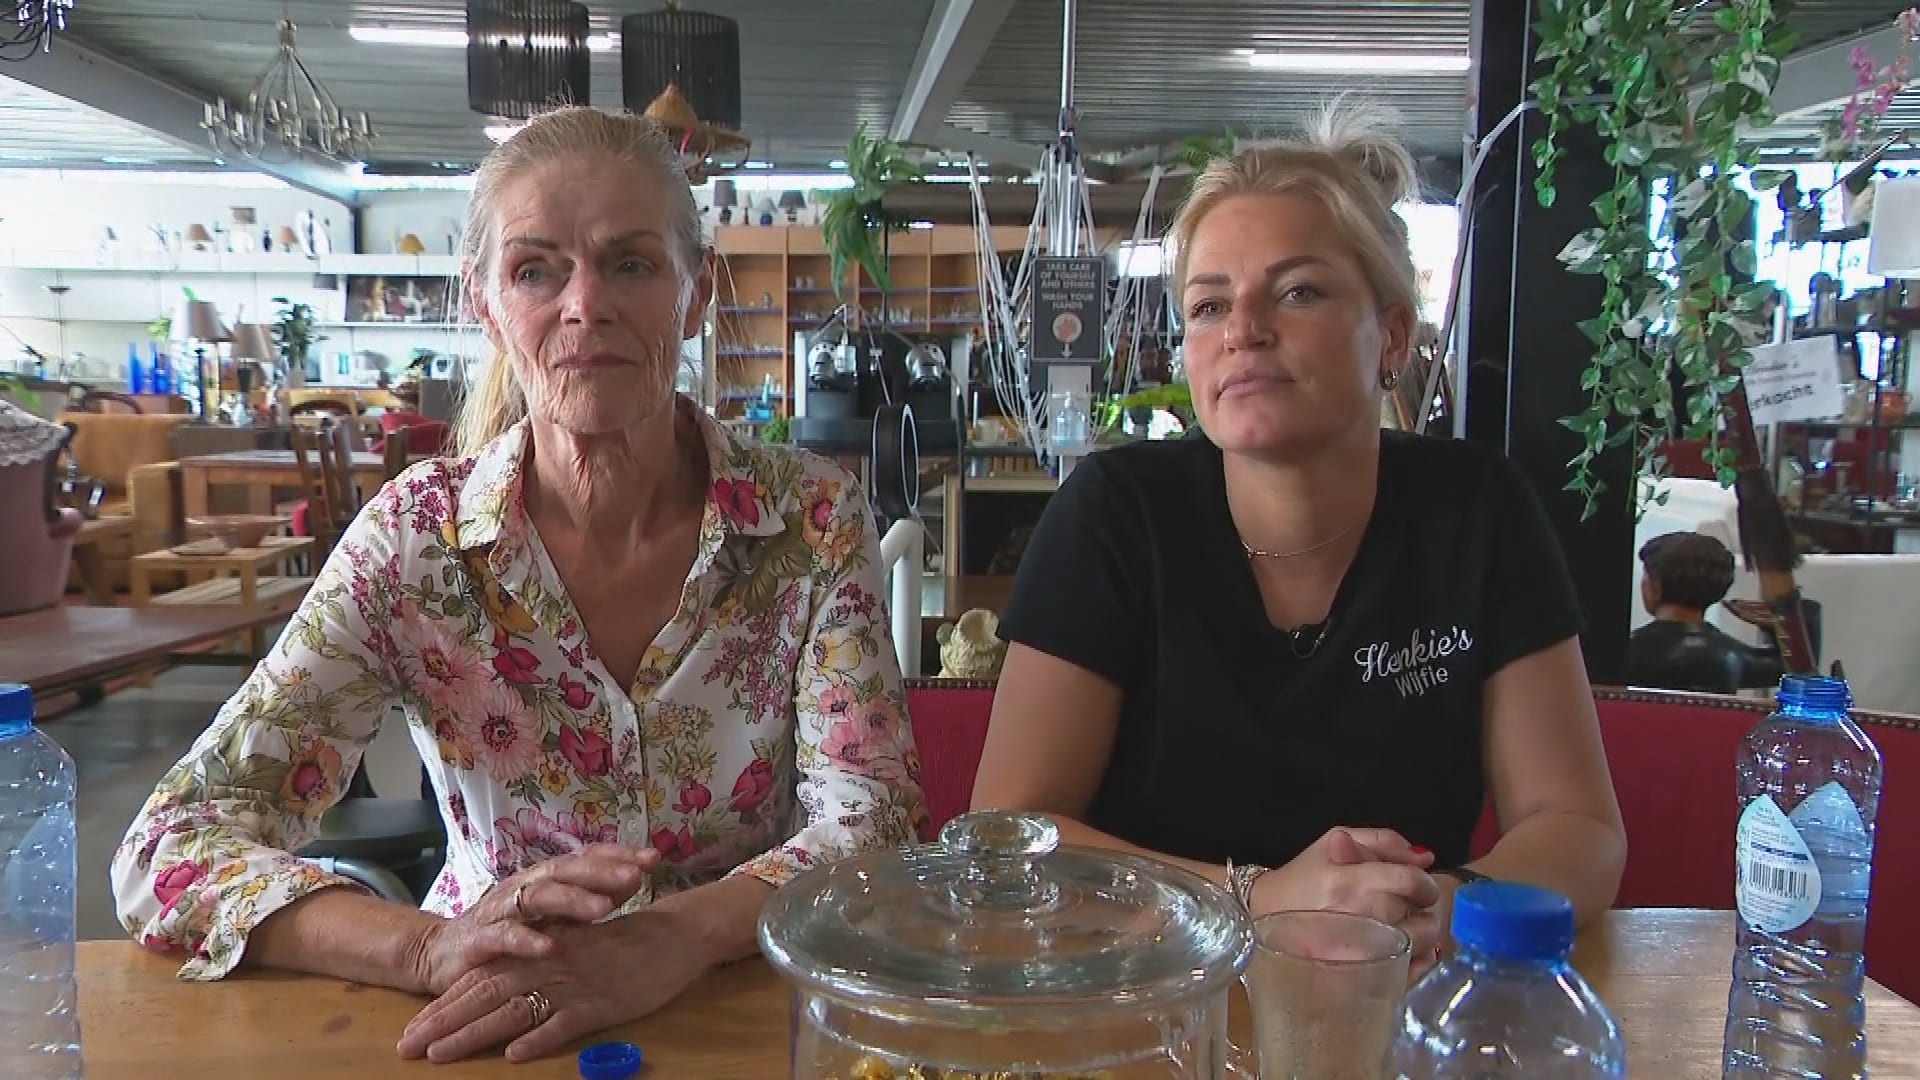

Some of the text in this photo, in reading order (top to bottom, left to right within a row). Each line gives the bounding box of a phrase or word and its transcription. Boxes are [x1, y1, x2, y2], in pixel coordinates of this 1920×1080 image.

[1046, 263, 1091, 271] TAKE CARE
[1040, 272, 1096, 280] OF YOURSELF
[1041, 281, 1096, 289] AND OTHERS
[1052, 302, 1083, 310] HANDS
[1354, 625, 1473, 683] Henkie's
[1394, 664, 1449, 700] Wijfie
